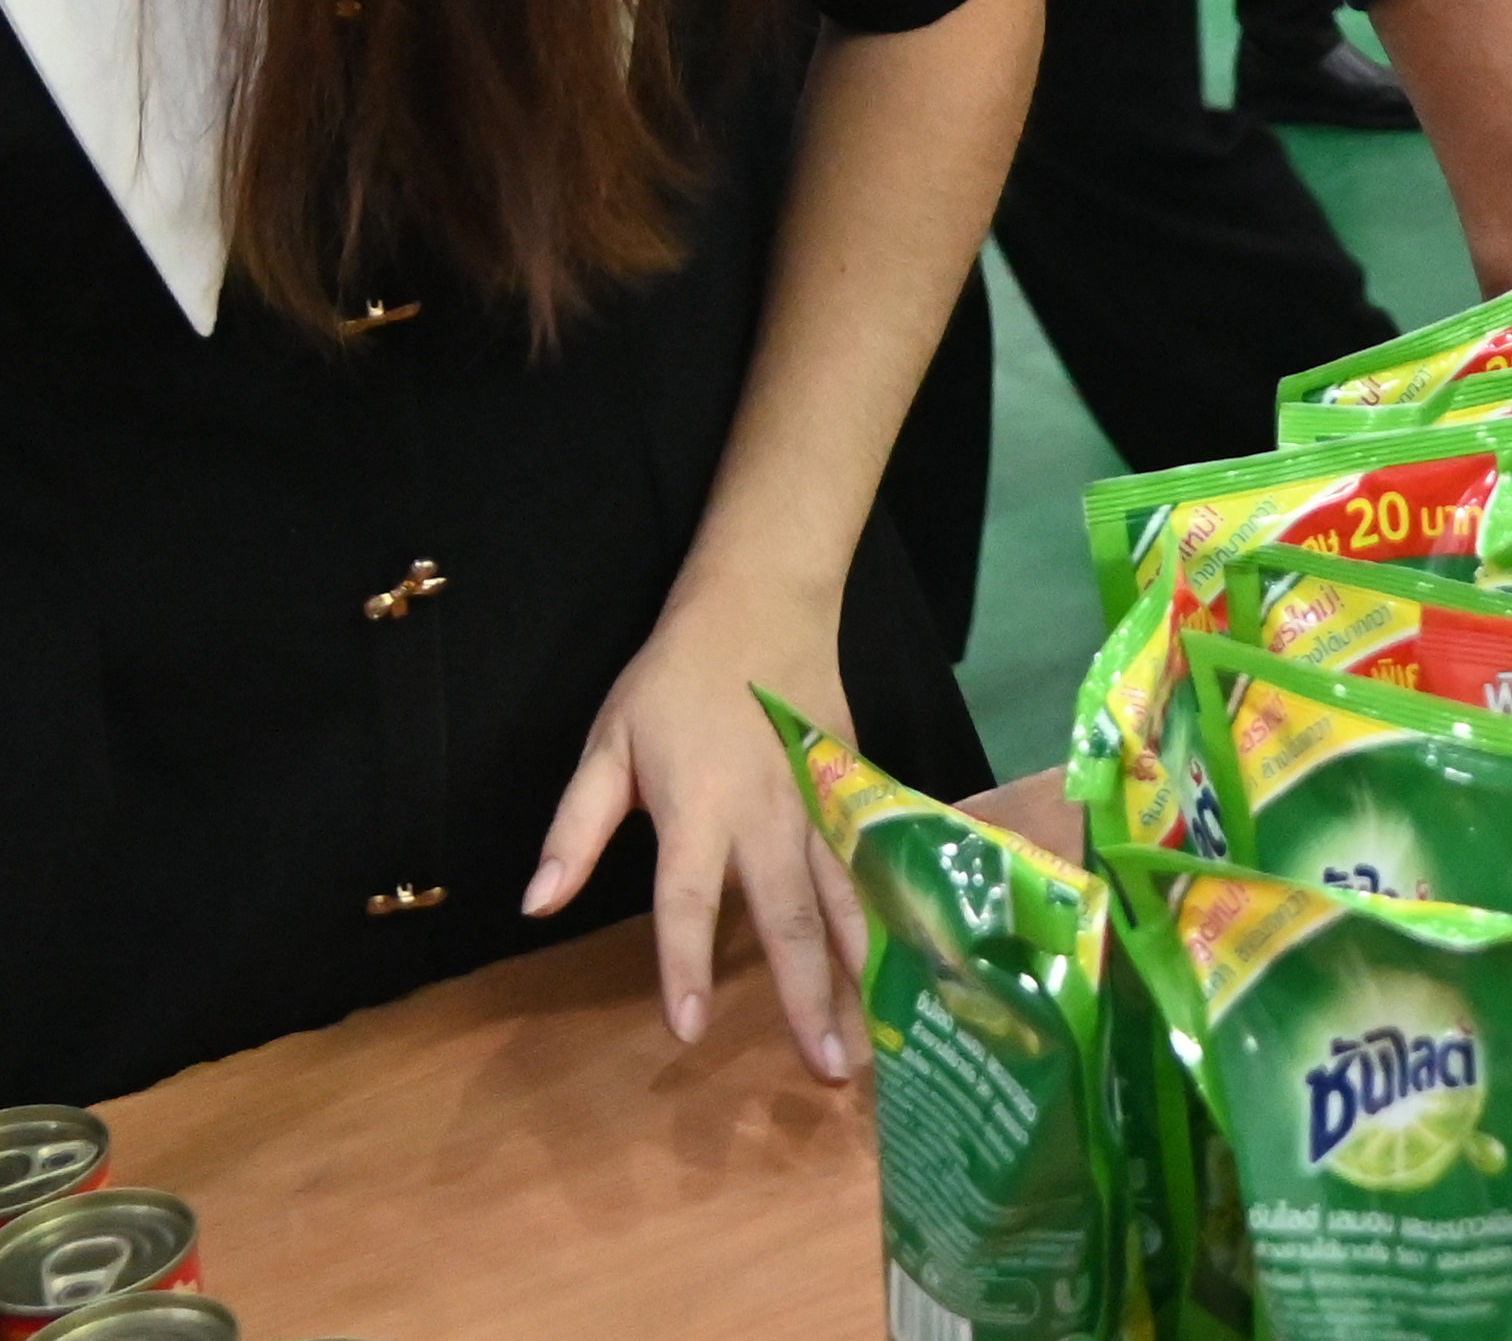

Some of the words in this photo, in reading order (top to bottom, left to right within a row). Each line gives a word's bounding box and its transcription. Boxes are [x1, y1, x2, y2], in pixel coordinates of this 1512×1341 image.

[1345, 490, 1411, 551] 20
[1305, 1015, 1479, 1164] ซันไลต์
